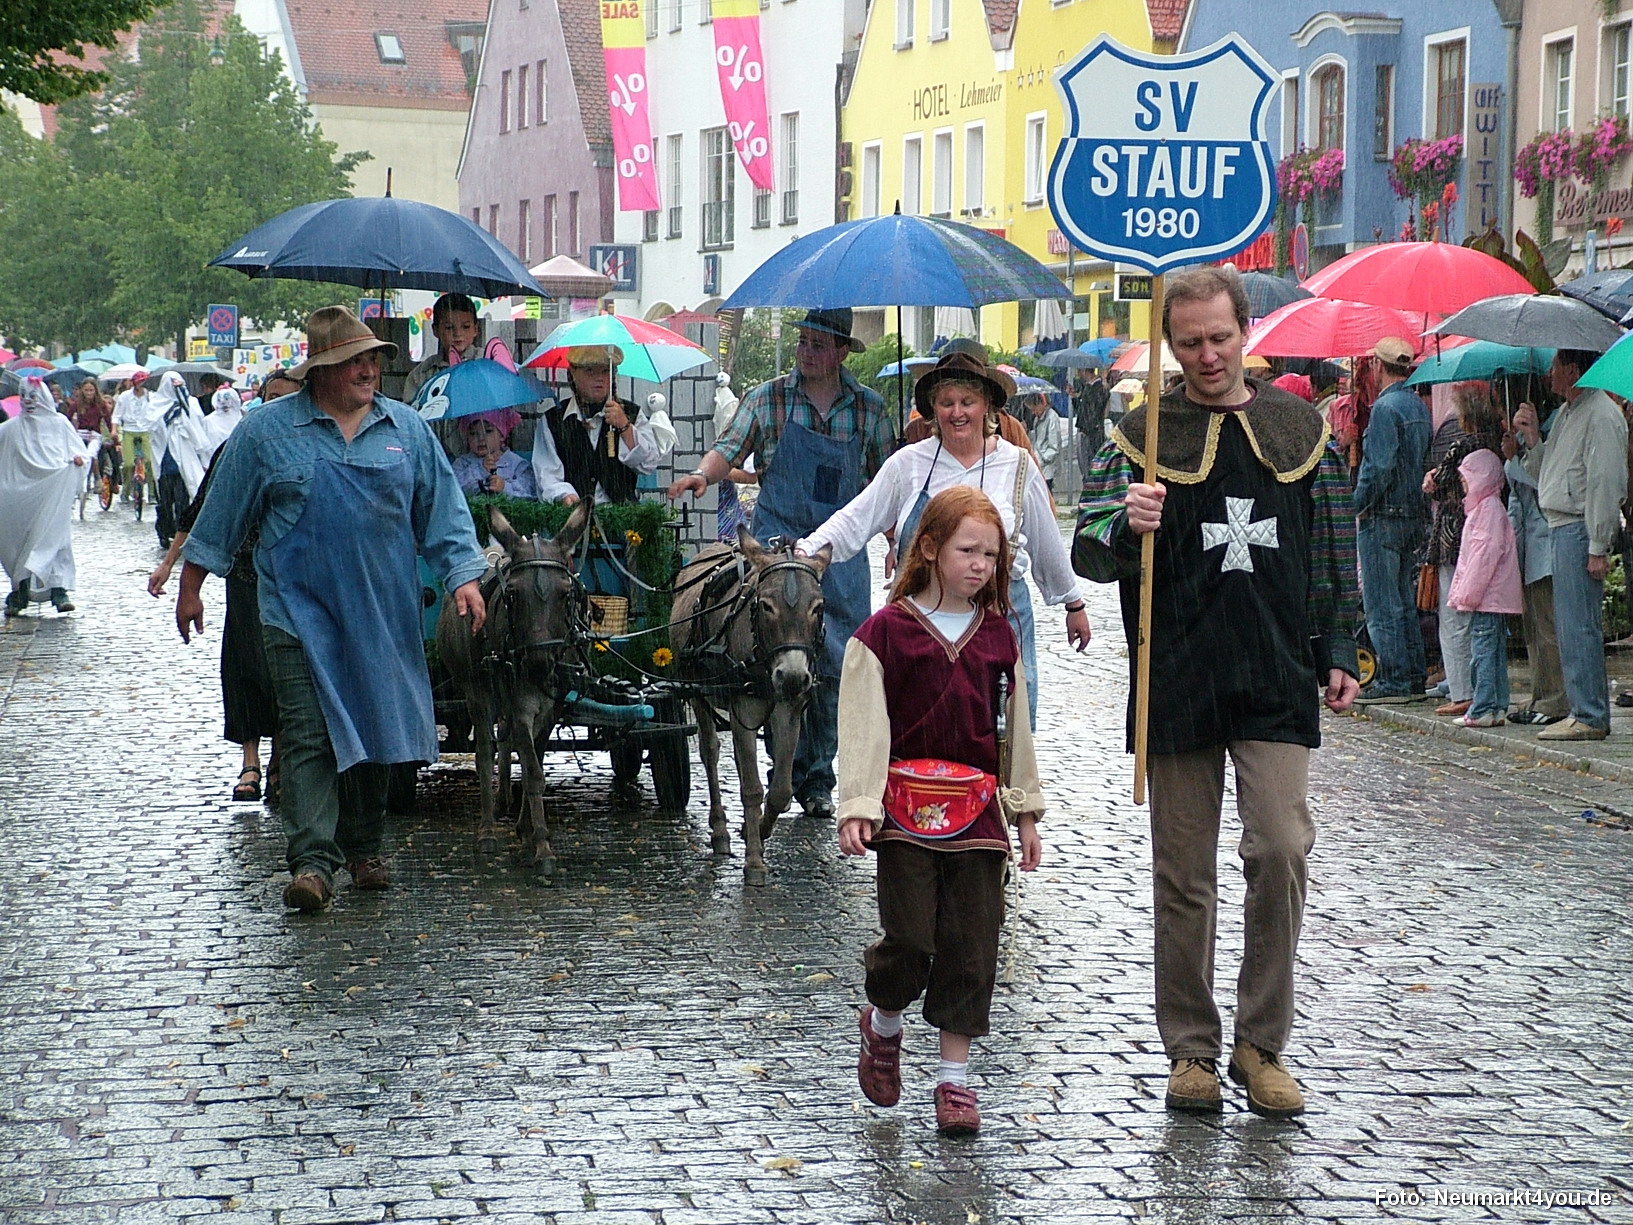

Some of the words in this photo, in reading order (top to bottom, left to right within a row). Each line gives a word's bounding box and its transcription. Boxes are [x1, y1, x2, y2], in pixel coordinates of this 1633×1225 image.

[913, 83, 950, 121] HOTEL
[960, 77, 1003, 109] Lehmeier
[1134, 80, 1200, 133] SV
[1090, 144, 1241, 199] STAUF
[1121, 206, 1201, 239] 1980
[210, 333, 234, 344] TAXI
